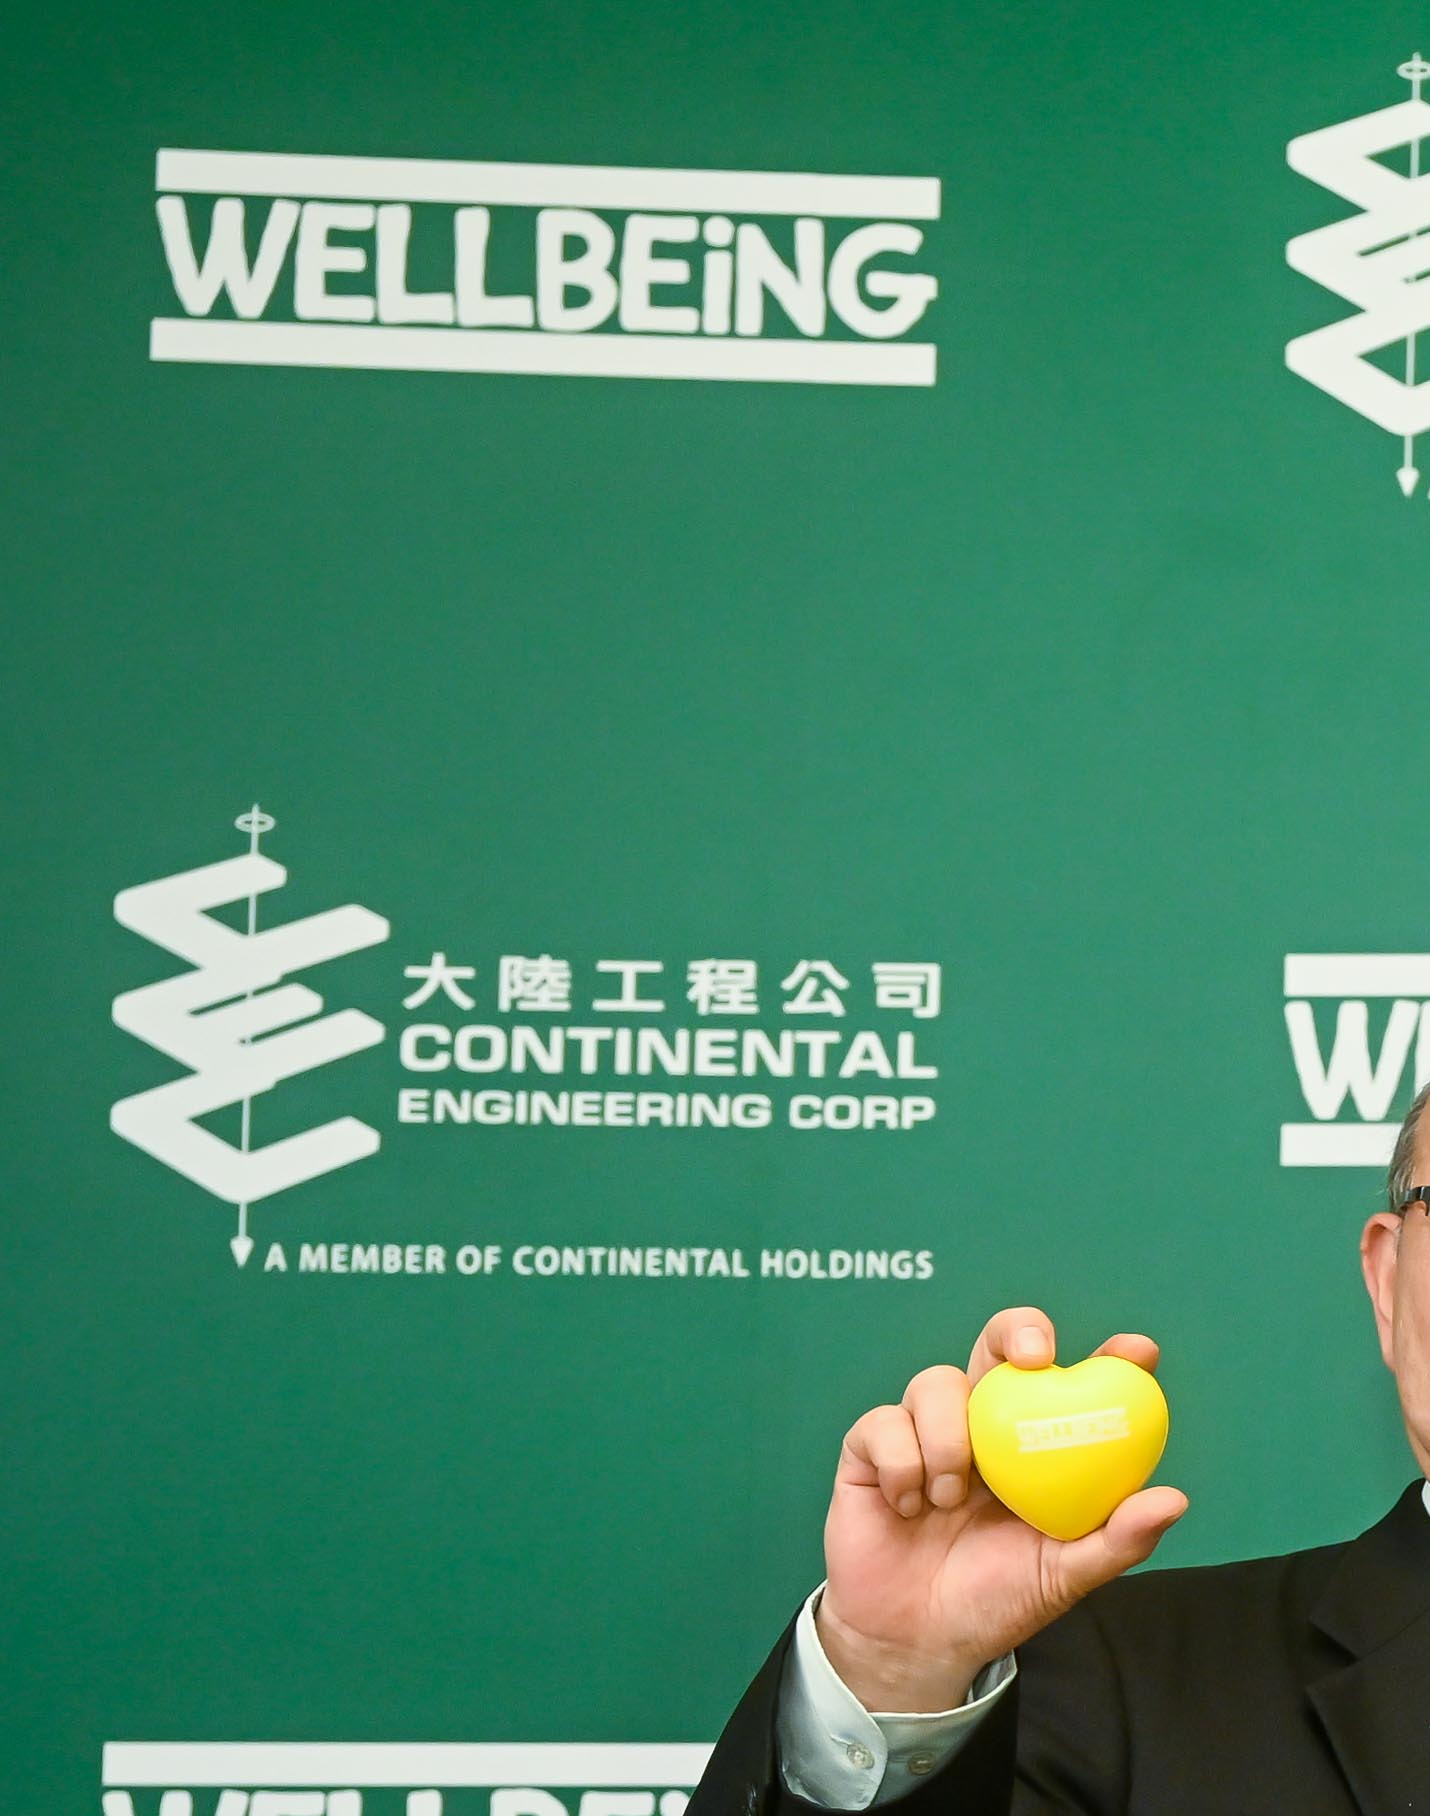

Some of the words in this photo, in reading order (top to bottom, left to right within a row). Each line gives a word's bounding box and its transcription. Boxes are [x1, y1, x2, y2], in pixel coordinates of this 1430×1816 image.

[403, 952, 942, 1019] 大陸工程公司
[399, 1023, 939, 1079] CONTINENTAL
[398, 1088, 772, 1128] ENGINEERING
[789, 1094, 936, 1130] CORP
[264, 1242, 287, 1272] A
[299, 1243, 446, 1274] MEMBER
[455, 1244, 501, 1275] OF
[512, 1245, 750, 1278] CONTINENTAL
[760, 1248, 934, 1280] HOLDINGS
